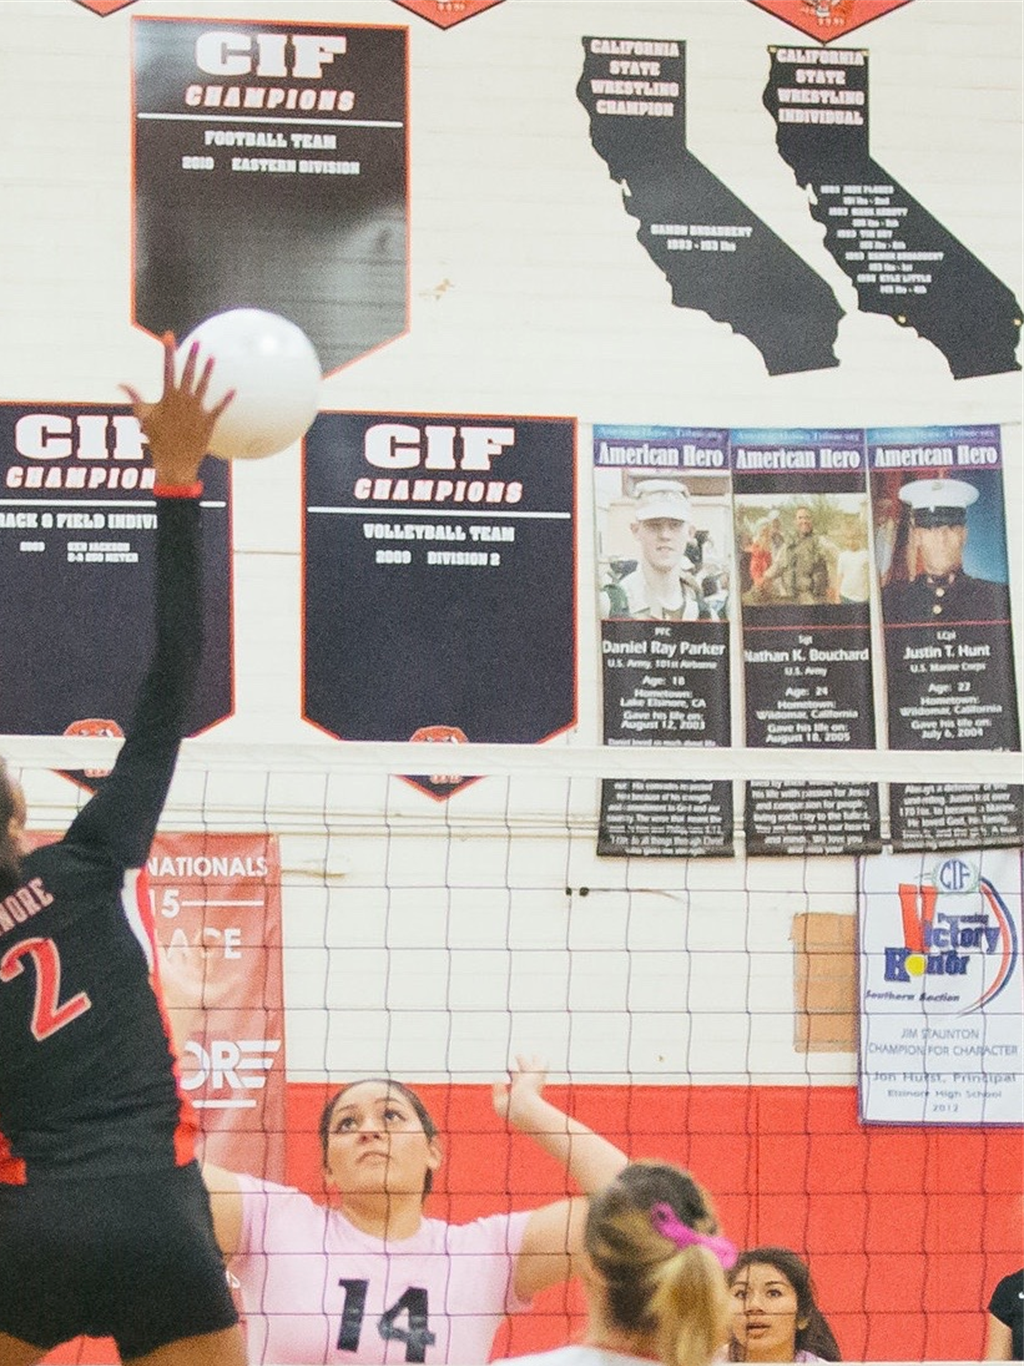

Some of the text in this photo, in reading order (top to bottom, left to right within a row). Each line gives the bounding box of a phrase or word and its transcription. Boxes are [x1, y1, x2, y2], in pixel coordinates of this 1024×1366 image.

[196, 31, 347, 79] CIF
[590, 39, 680, 57] CALIFORNIA
[776, 48, 865, 66] CALIFORNIA
[609, 60, 661, 76] STATE
[795, 68, 846, 85] STATE
[590, 79, 679, 97] WRESTLING
[777, 88, 865, 106] WRESTLING
[184, 84, 355, 111] CHAMPIONS
[596, 99, 674, 117] CHAMPION
[778, 108, 864, 125] INDIVIDUAL
[205, 130, 337, 149] FOOTBALL TEAM
[231, 157, 360, 175] EASTERN DIVISION
[364, 423, 516, 471] CIF
[599, 441, 724, 467] American Hero
[875, 445, 998, 467] American Hero
[736, 448, 861, 470] American Hero
[6, 466, 156, 490] CHAMPION
[354, 478, 524, 504] CHAMPIONS
[56, 513, 106, 530] FIELD
[363, 523, 515, 542] VOLLEYBALL TEAM
[427, 551, 488, 566] DIVISION
[602, 640, 726, 658] Daniel Ray Parker
[744, 647, 869, 662] Nathan K. Bouchard
[903, 644, 991, 660] Justin T. Hunt
[148, 856, 268, 877] NATIONALS
[939, 859, 970, 890] CIF
[0, 937, 92, 1042] 2
[901, 1029, 918, 1039] JIM
[337, 1278, 436, 1363] 14
